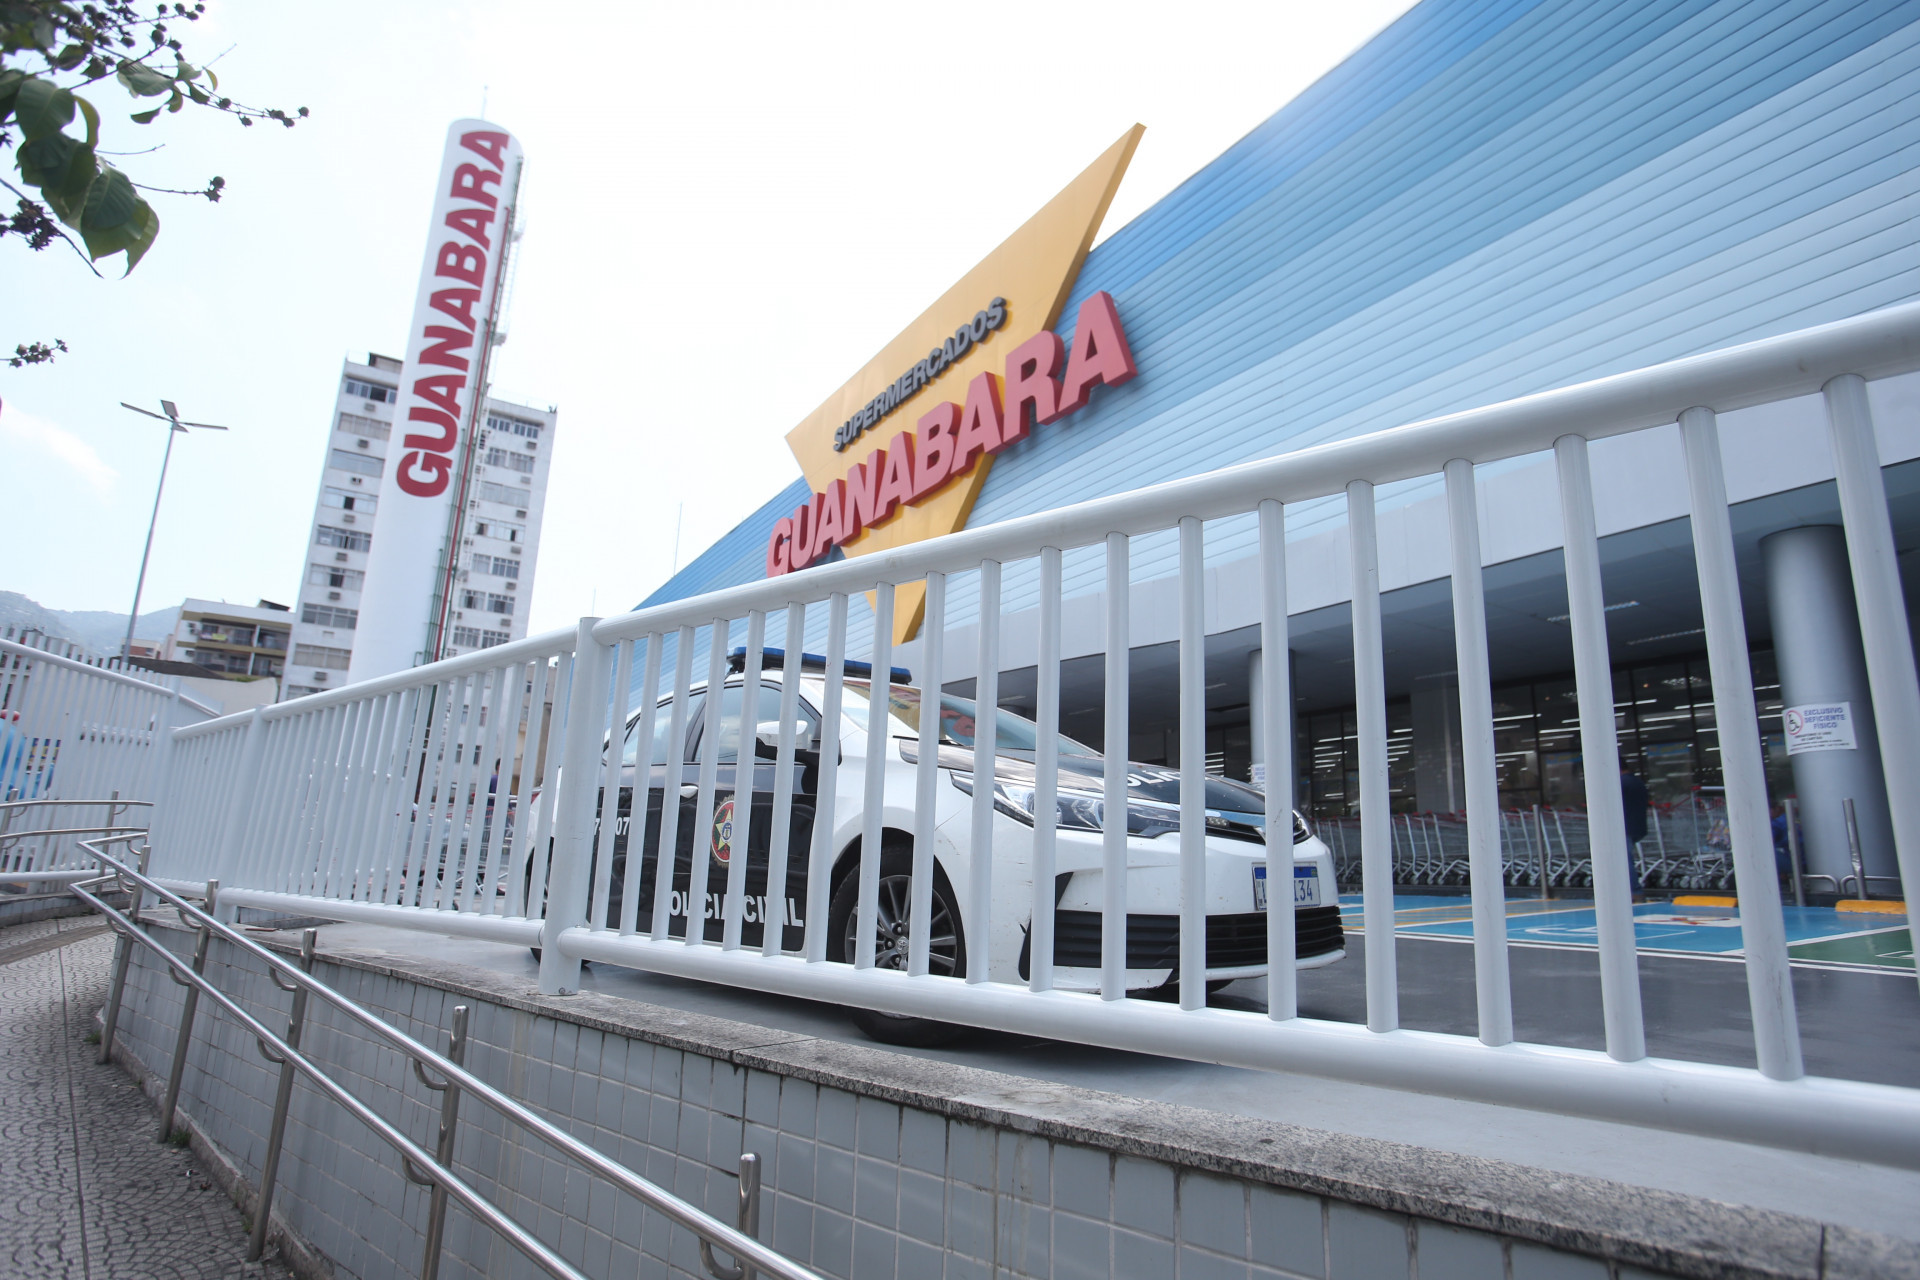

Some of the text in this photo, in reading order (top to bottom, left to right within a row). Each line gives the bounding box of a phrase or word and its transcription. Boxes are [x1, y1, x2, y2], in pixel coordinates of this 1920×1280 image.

[396, 131, 509, 497] GUANABARA
[833, 296, 1007, 452] SUPERMERCADOS
[766, 290, 1137, 578] GUANABARA
[1804, 707, 1843, 716] EXCLUSIVO
[1804, 714, 1845, 723] DEFICIENTE
[742, 895, 804, 927] CIIL
